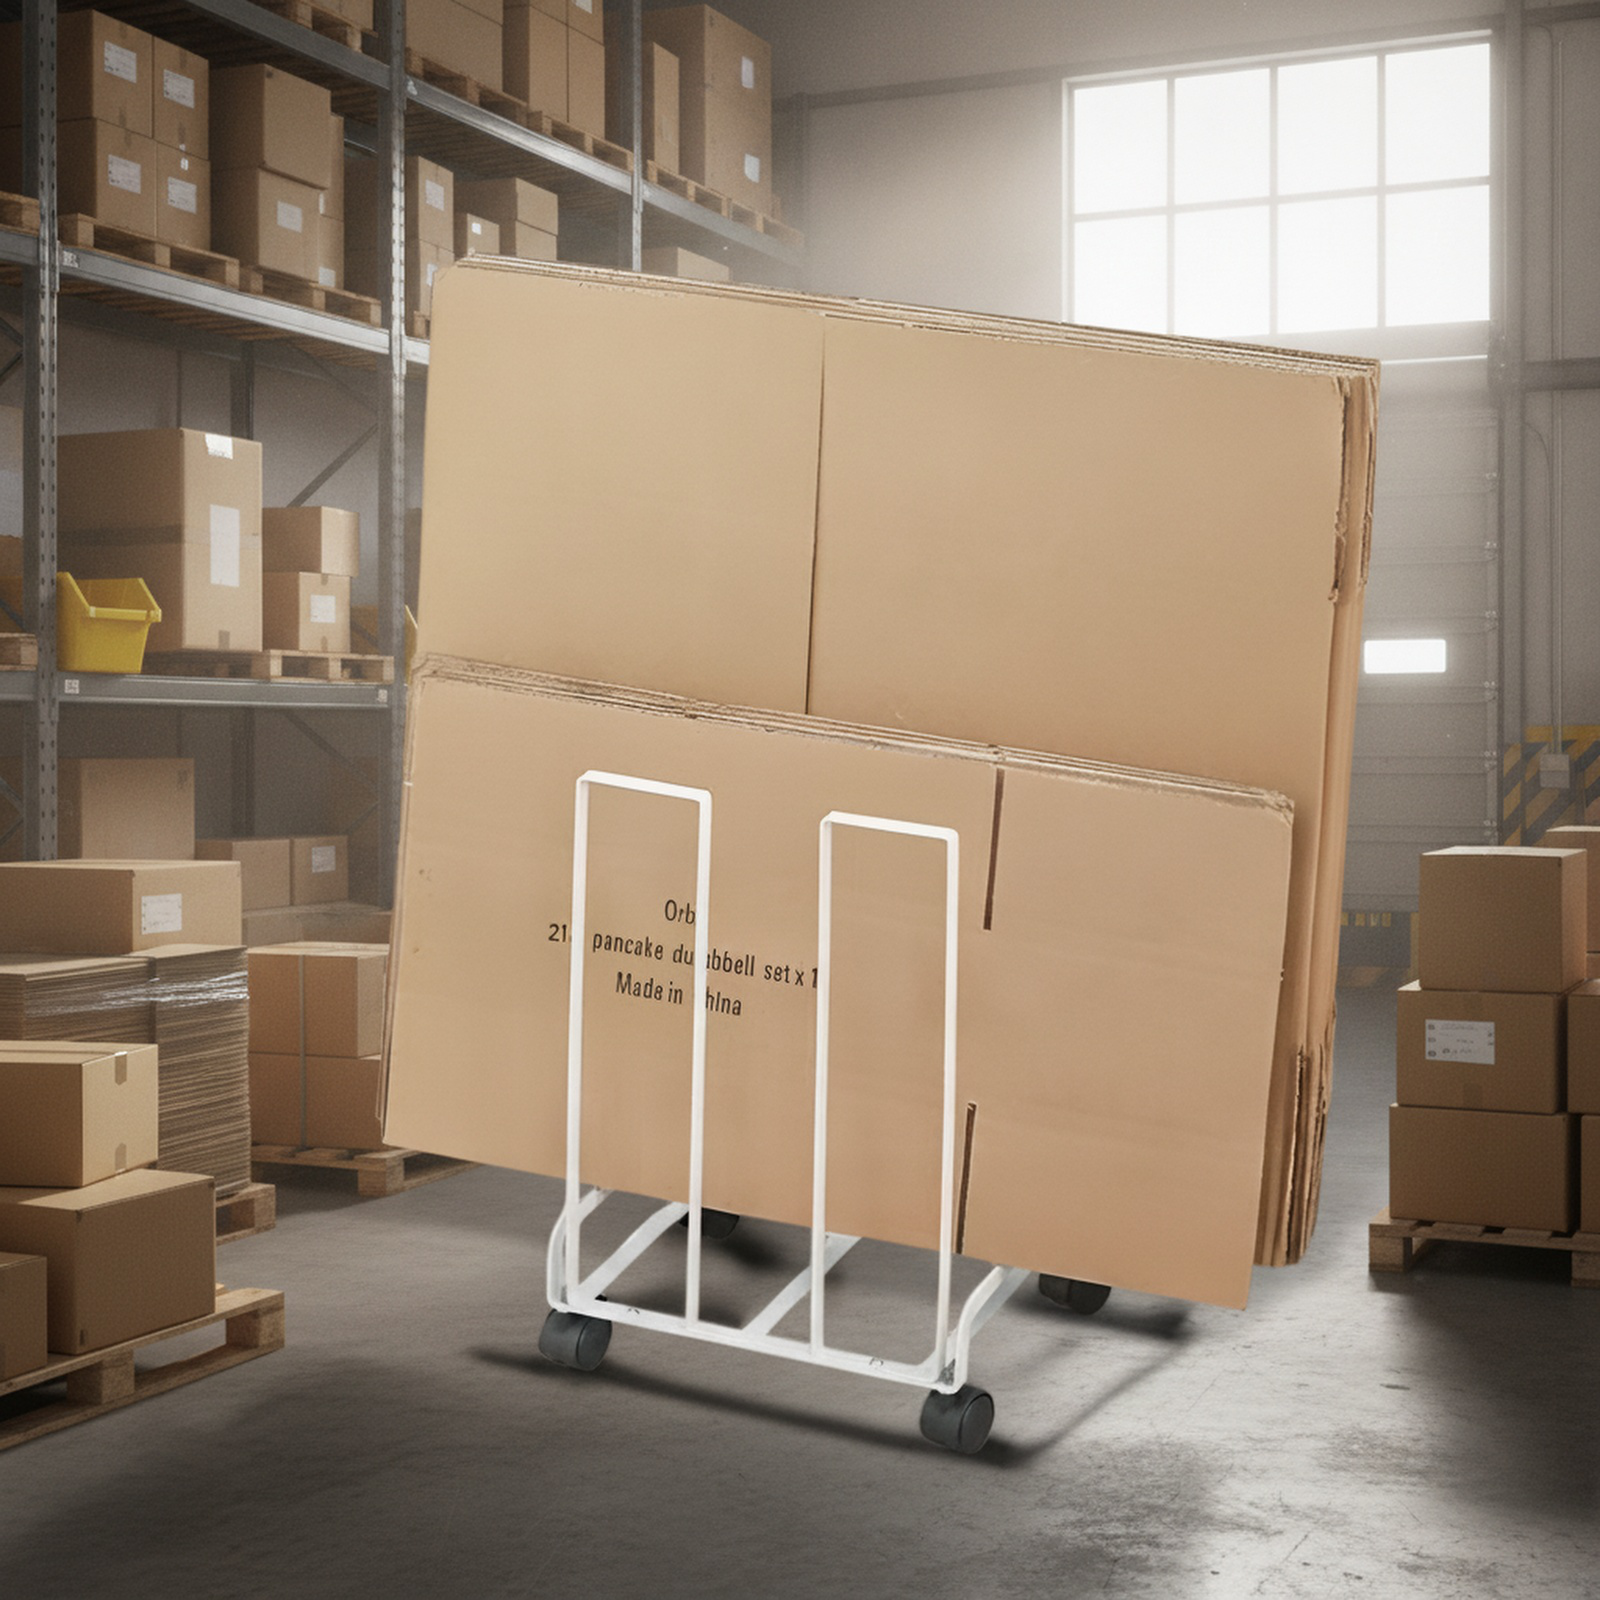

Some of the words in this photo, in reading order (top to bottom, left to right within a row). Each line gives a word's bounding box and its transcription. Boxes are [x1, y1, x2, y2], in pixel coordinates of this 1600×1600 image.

[548, 923, 572, 942] 21
[592, 933, 663, 960] pancake
[763, 964, 790, 984] set
[615, 971, 663, 1001] Made
[667, 980, 684, 1004] in
[705, 986, 742, 1016] hina
